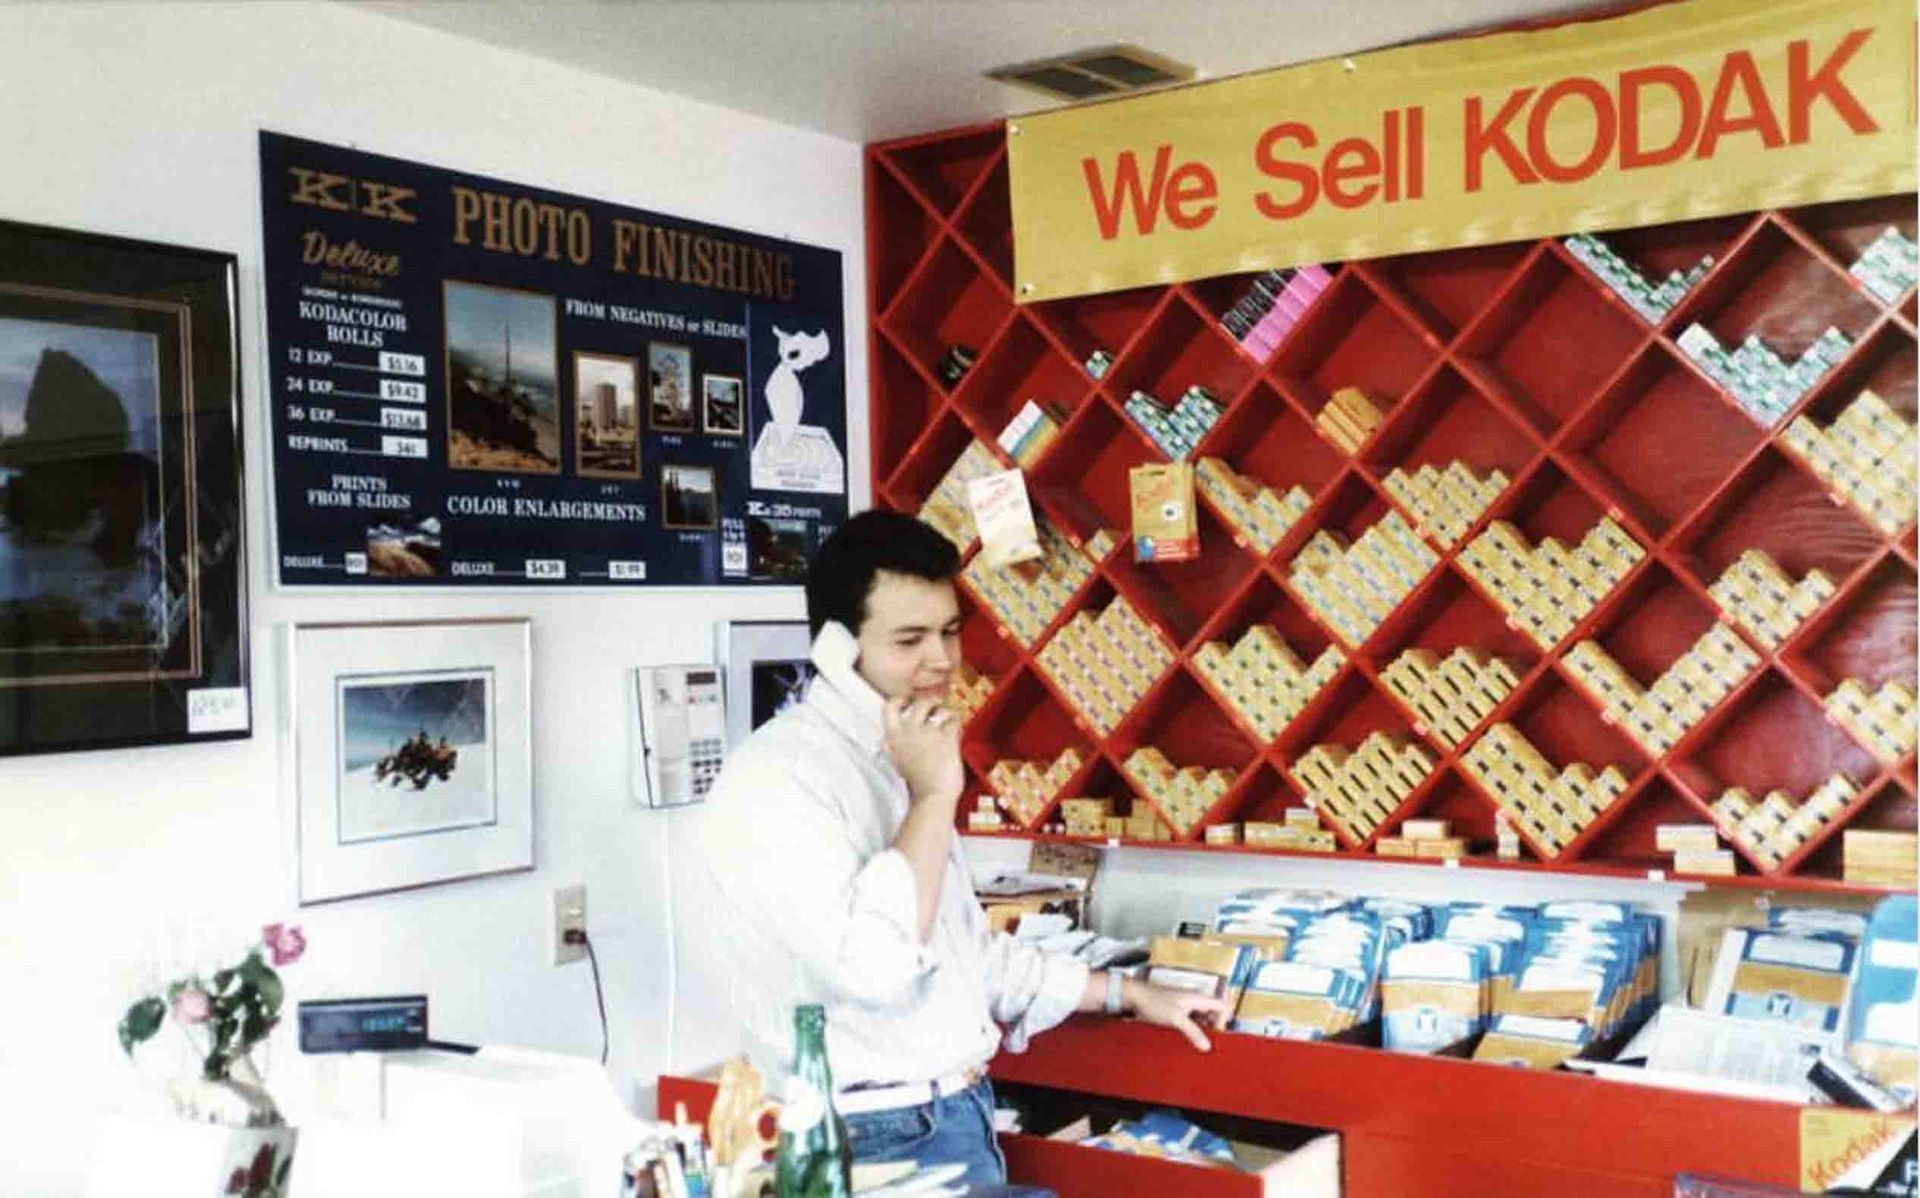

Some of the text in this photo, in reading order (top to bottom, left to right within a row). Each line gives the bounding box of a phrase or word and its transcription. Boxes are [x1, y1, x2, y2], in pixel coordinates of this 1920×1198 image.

[1085, 29, 1878, 238] We Sell KODAK
[302, 230, 400, 277] Deluxe
[453, 187, 796, 299] PHOTO FINISHING
[299, 300, 407, 332] KODACOLOR
[565, 299, 605, 320] FROM
[610, 305, 685, 331] NEGATIVES
[702, 319, 747, 339] SLIDES
[327, 325, 384, 347] ROLLS
[288, 348, 302, 363] 12
[286, 376, 303, 392] 24
[287, 404, 305, 421] 36
[288, 435, 349, 453] REPRINTS
[331, 474, 387, 492] PRINTS
[307, 489, 411, 510] FROM SLIDES
[446, 495, 647, 522] COLOR ENLARGEMENTS
[451, 561, 495, 576] DELUXE
